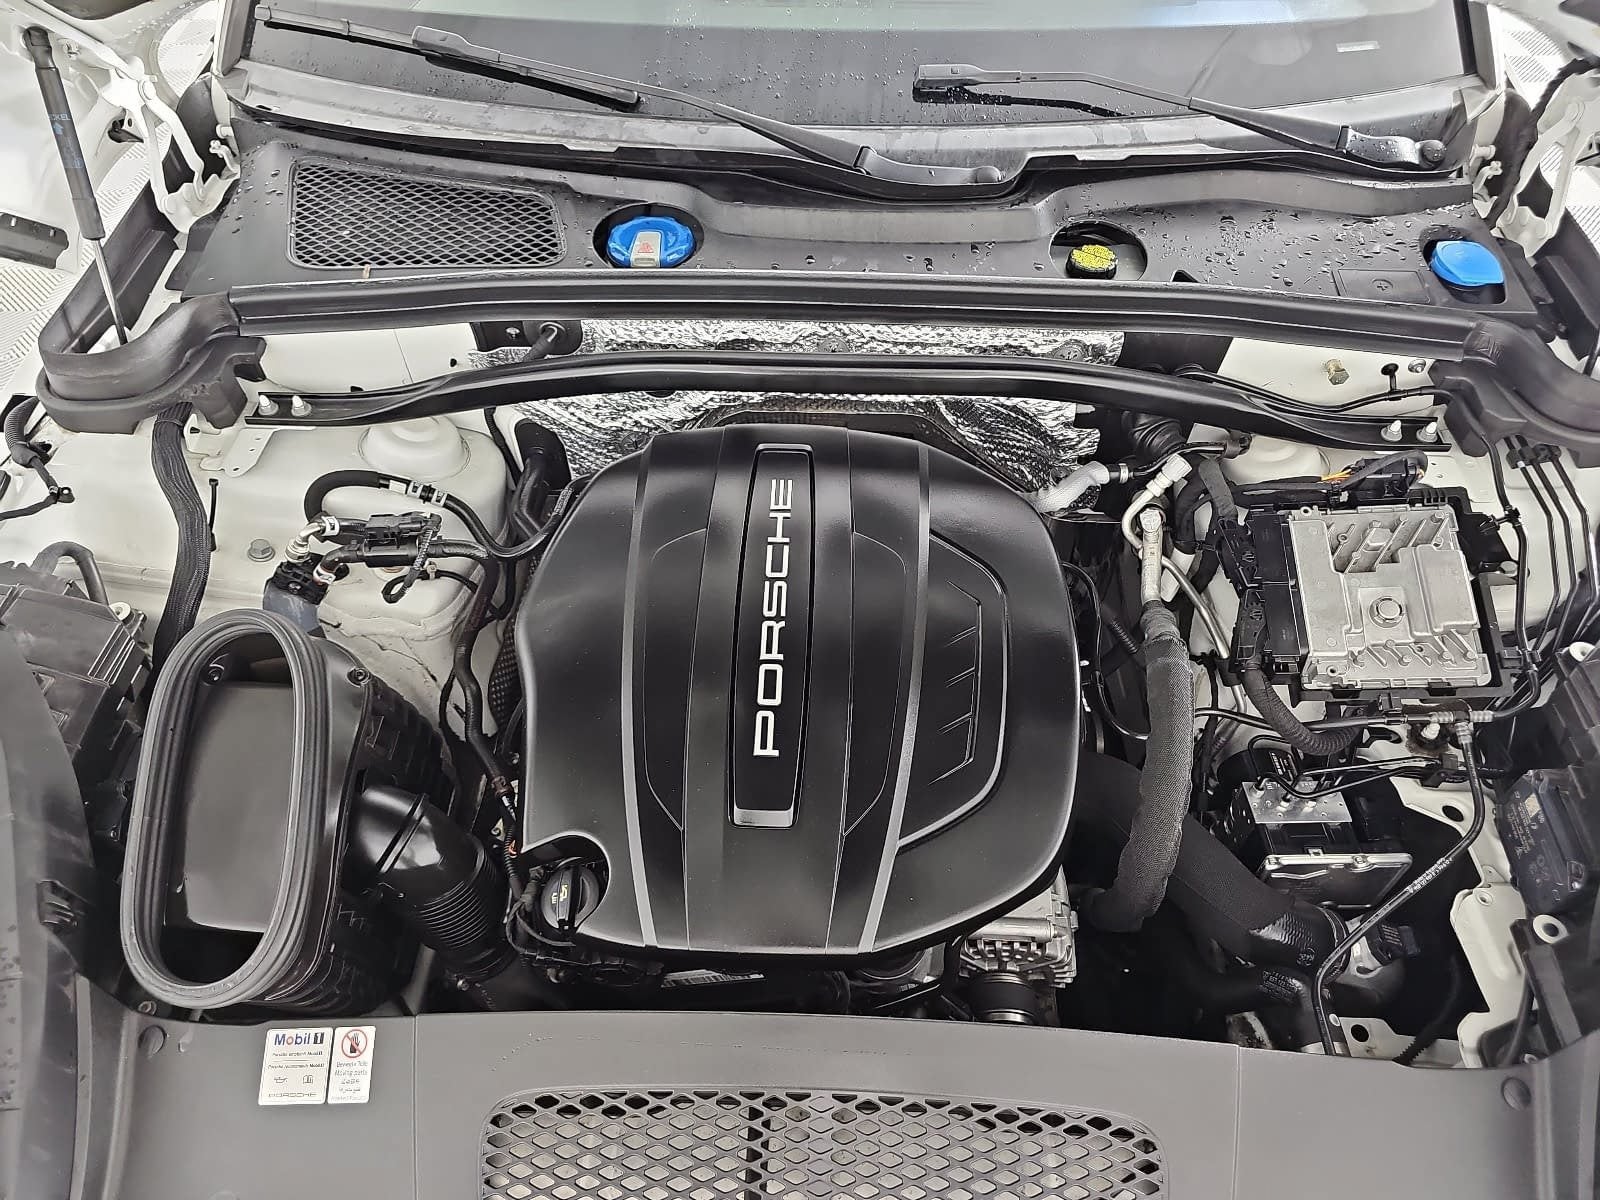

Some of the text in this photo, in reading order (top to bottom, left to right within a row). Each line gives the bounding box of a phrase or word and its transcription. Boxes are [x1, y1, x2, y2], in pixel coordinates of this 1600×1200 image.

[752, 478, 793, 757] PORSCHE
[274, 1032, 325, 1046] Mobil 1
